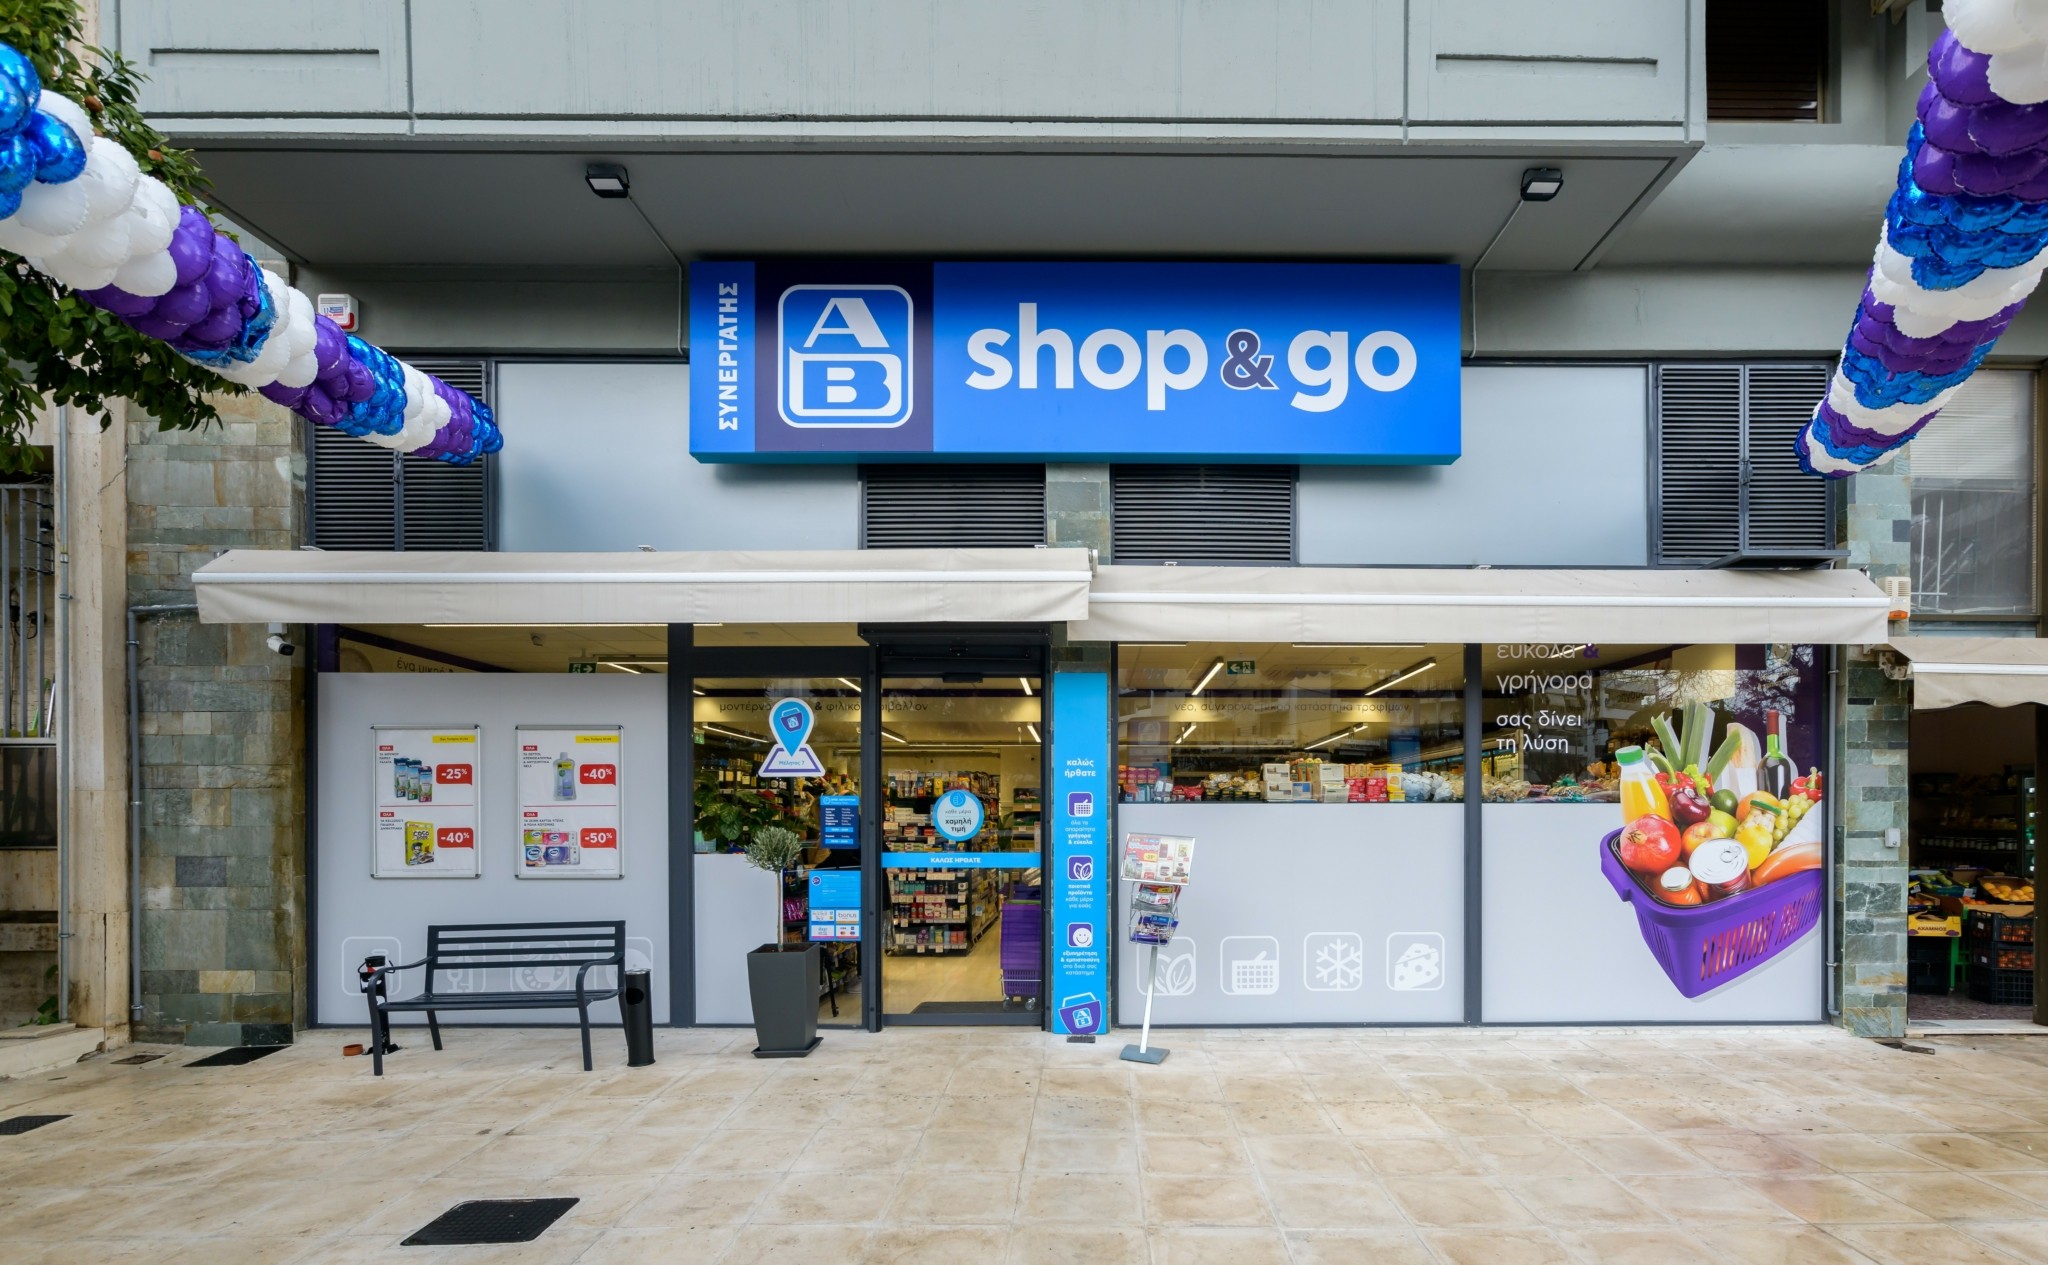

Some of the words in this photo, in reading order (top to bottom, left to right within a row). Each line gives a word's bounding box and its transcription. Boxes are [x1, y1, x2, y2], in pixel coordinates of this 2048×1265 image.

[718, 282, 738, 431] ΣΥΝΕΡΓΑΤΗΣ
[965, 302, 1209, 411] shop
[1219, 328, 1280, 391] &
[1287, 328, 1418, 413] go
[1496, 669, 1593, 694] γρήγορα
[1496, 714, 1532, 730] σας
[1538, 710, 1582, 727] δίνει
[1496, 738, 1516, 754] τη
[1522, 734, 1569, 754] λύση
[1066, 757, 1094, 768] καλώς
[441, 768, 468, 780] -25%
[583, 768, 612, 780] -40%
[1064, 768, 1096, 778] ήρθατε
[945, 817, 972, 826] χαμηλή
[440, 832, 470, 844] -40%
[584, 832, 613, 844] -50%
